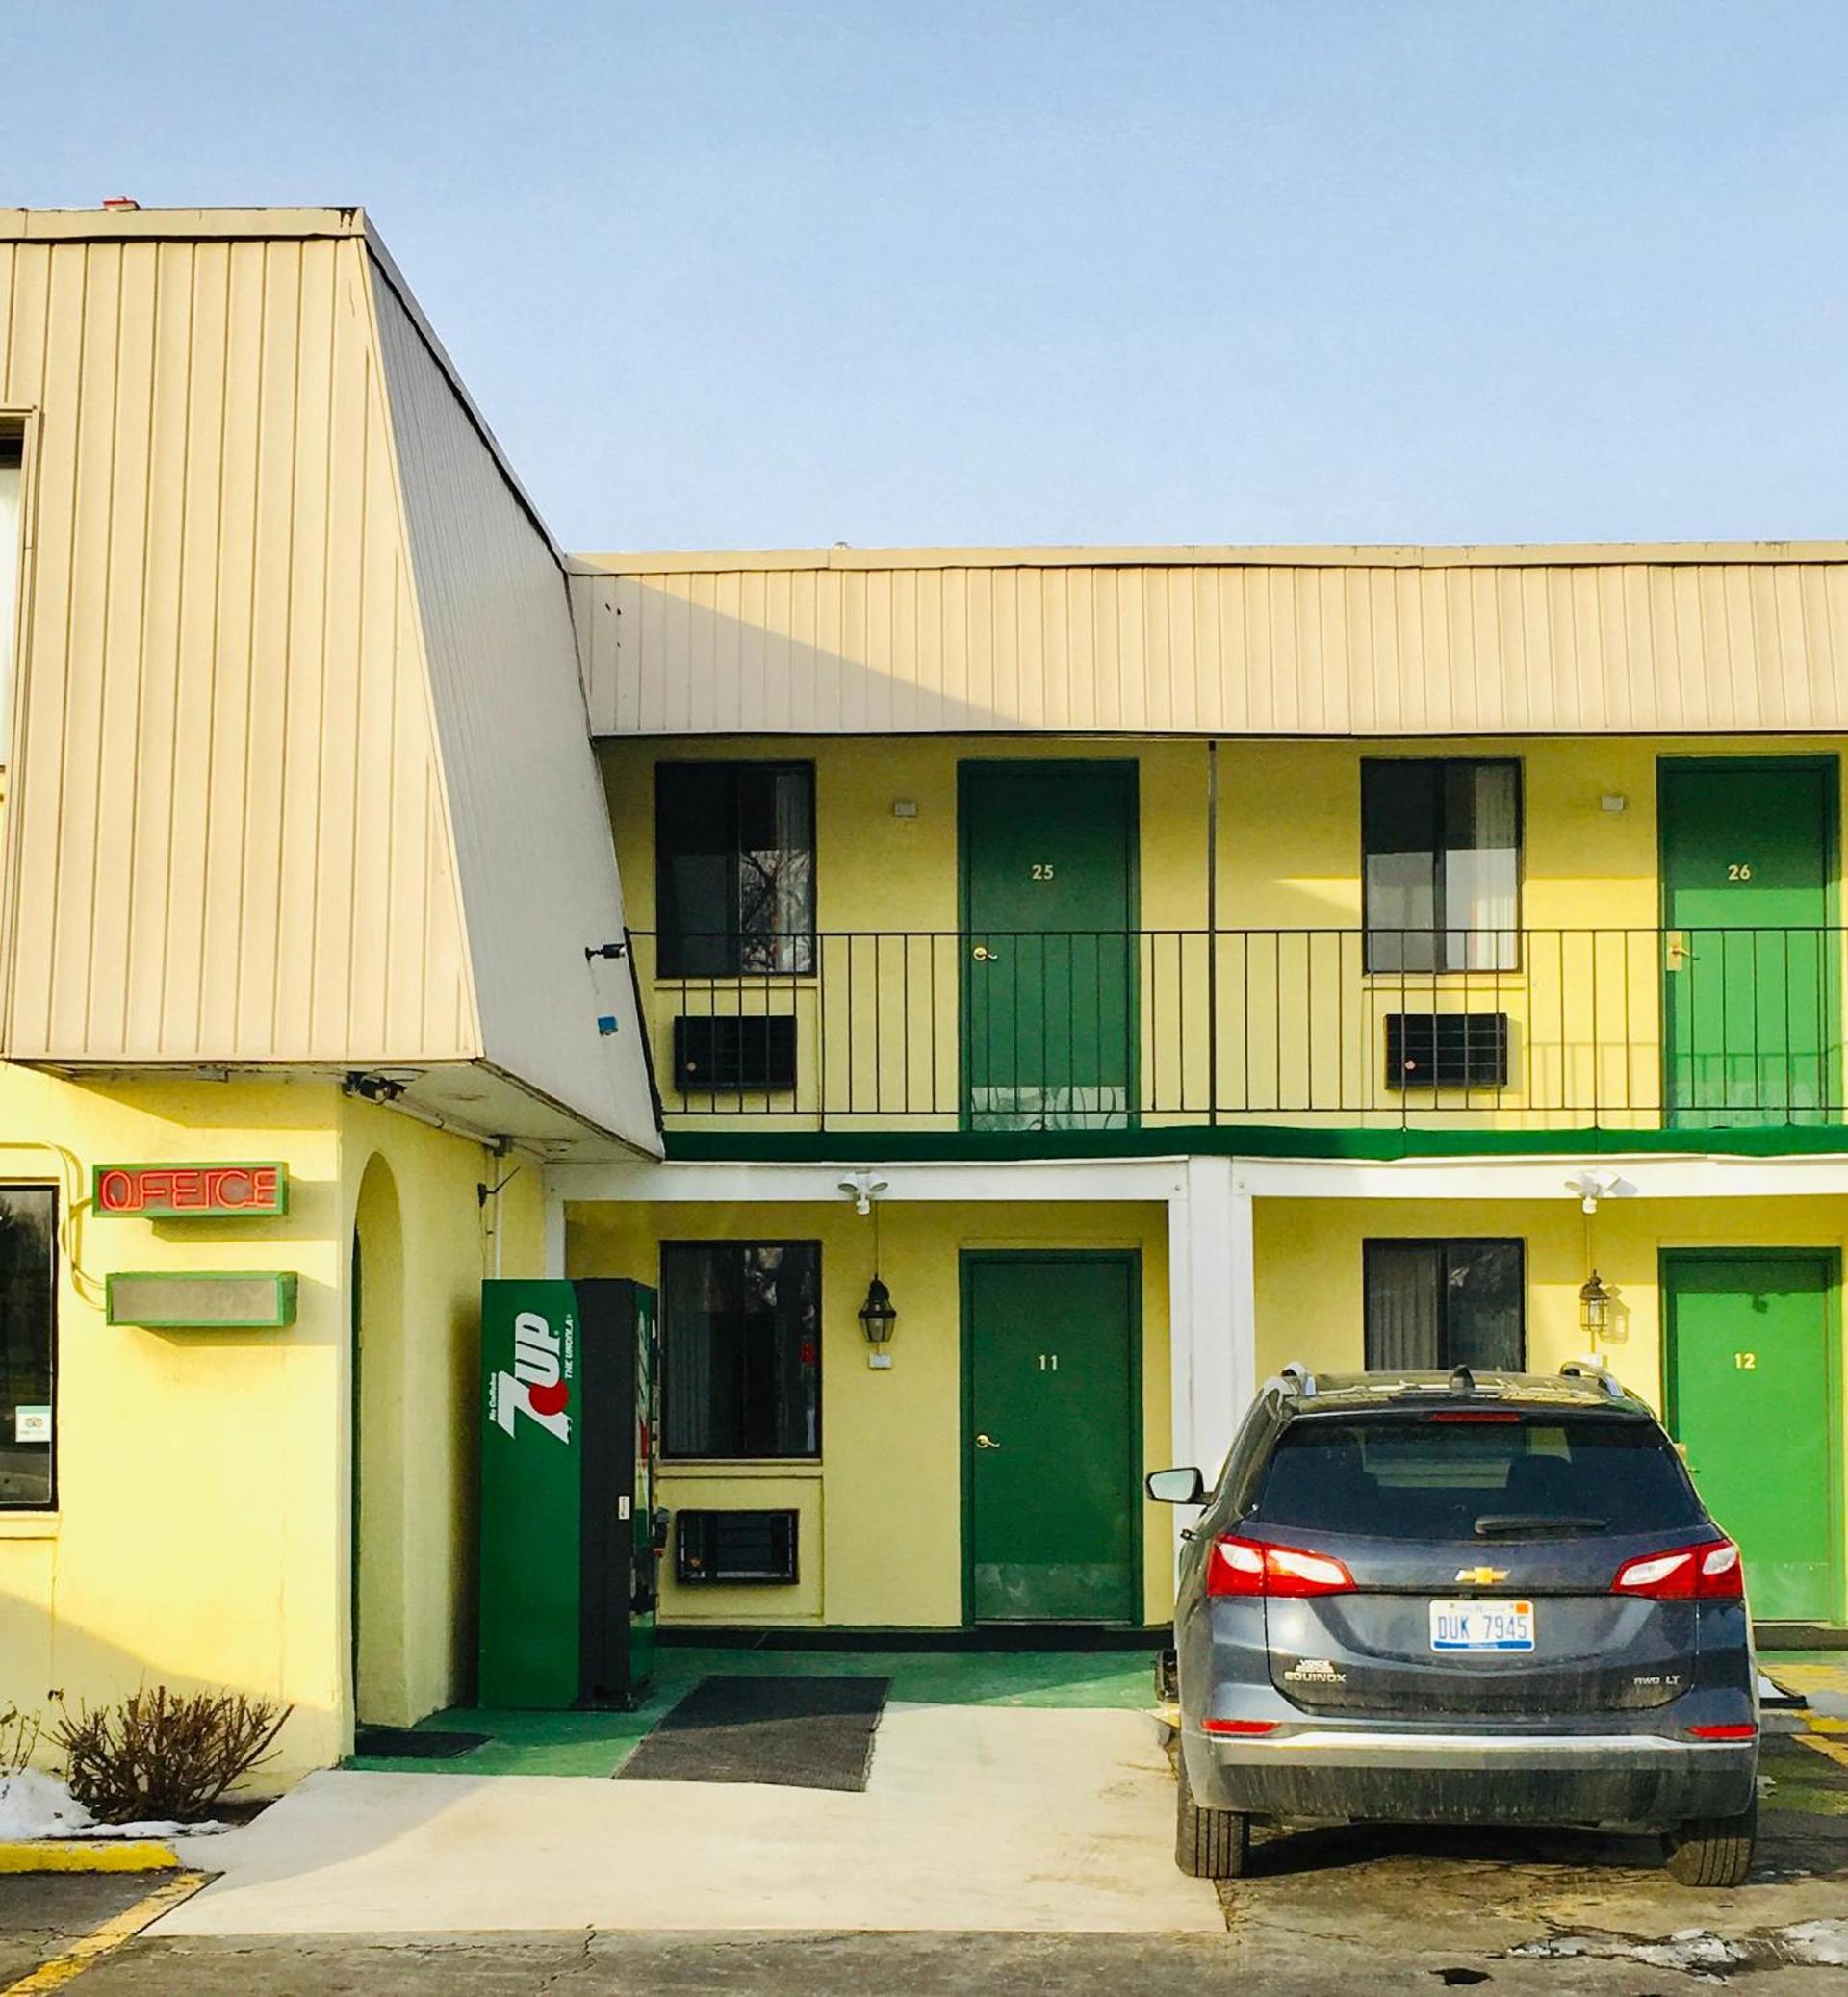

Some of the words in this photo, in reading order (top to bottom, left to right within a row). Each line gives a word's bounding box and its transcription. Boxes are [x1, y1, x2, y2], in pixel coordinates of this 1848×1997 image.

[1032, 864, 1054, 880] 25
[1728, 864, 1751, 881] 26
[101, 1169, 277, 1211] OFFICE
[1040, 1354, 1058, 1370] 11
[1734, 1353, 1756, 1369] 12
[498, 1312, 570, 1445] 7UP
[1438, 1616, 1470, 1639] DUK
[1483, 1616, 1527, 1639] 7945
[1284, 1671, 1348, 1682] EQUINOX
[1665, 1675, 1681, 1685] LT
